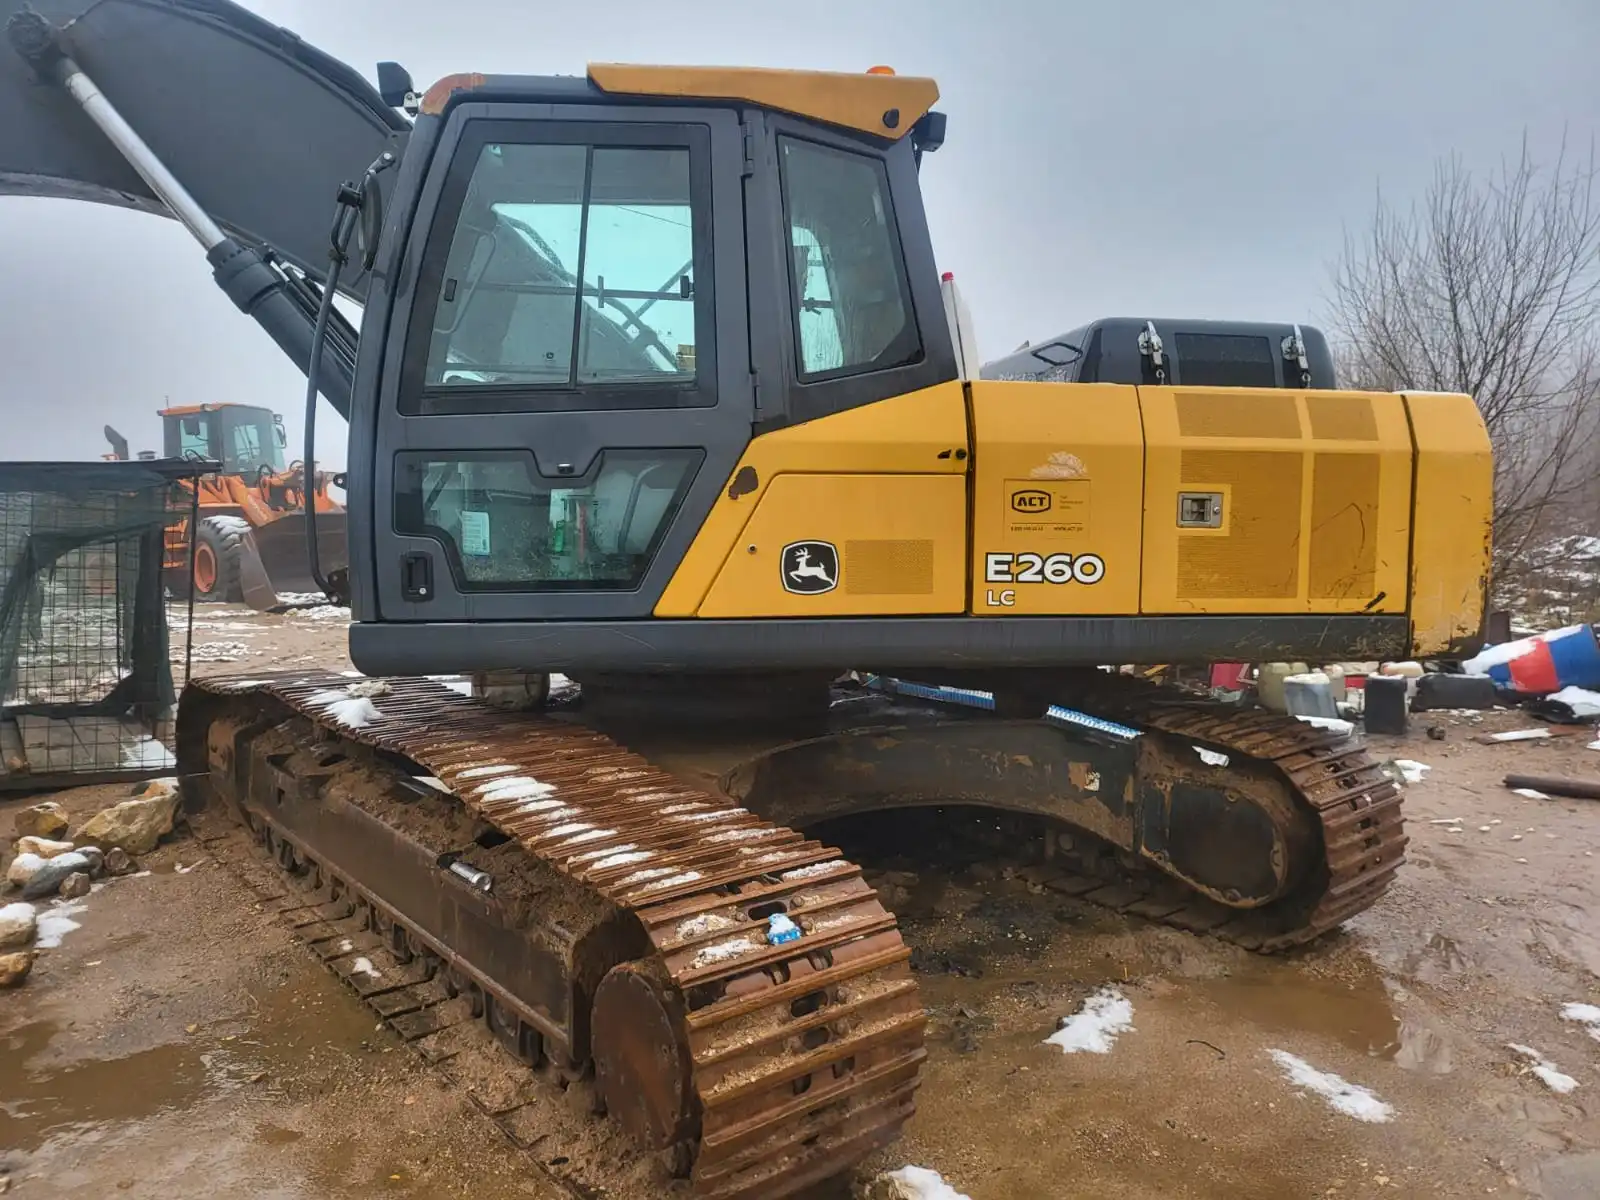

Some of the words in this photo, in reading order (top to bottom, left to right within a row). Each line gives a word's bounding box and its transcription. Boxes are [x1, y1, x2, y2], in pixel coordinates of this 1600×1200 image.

[1017, 497, 1046, 507] ACT
[985, 552, 1105, 585] E260
[987, 589, 1015, 606] LC
